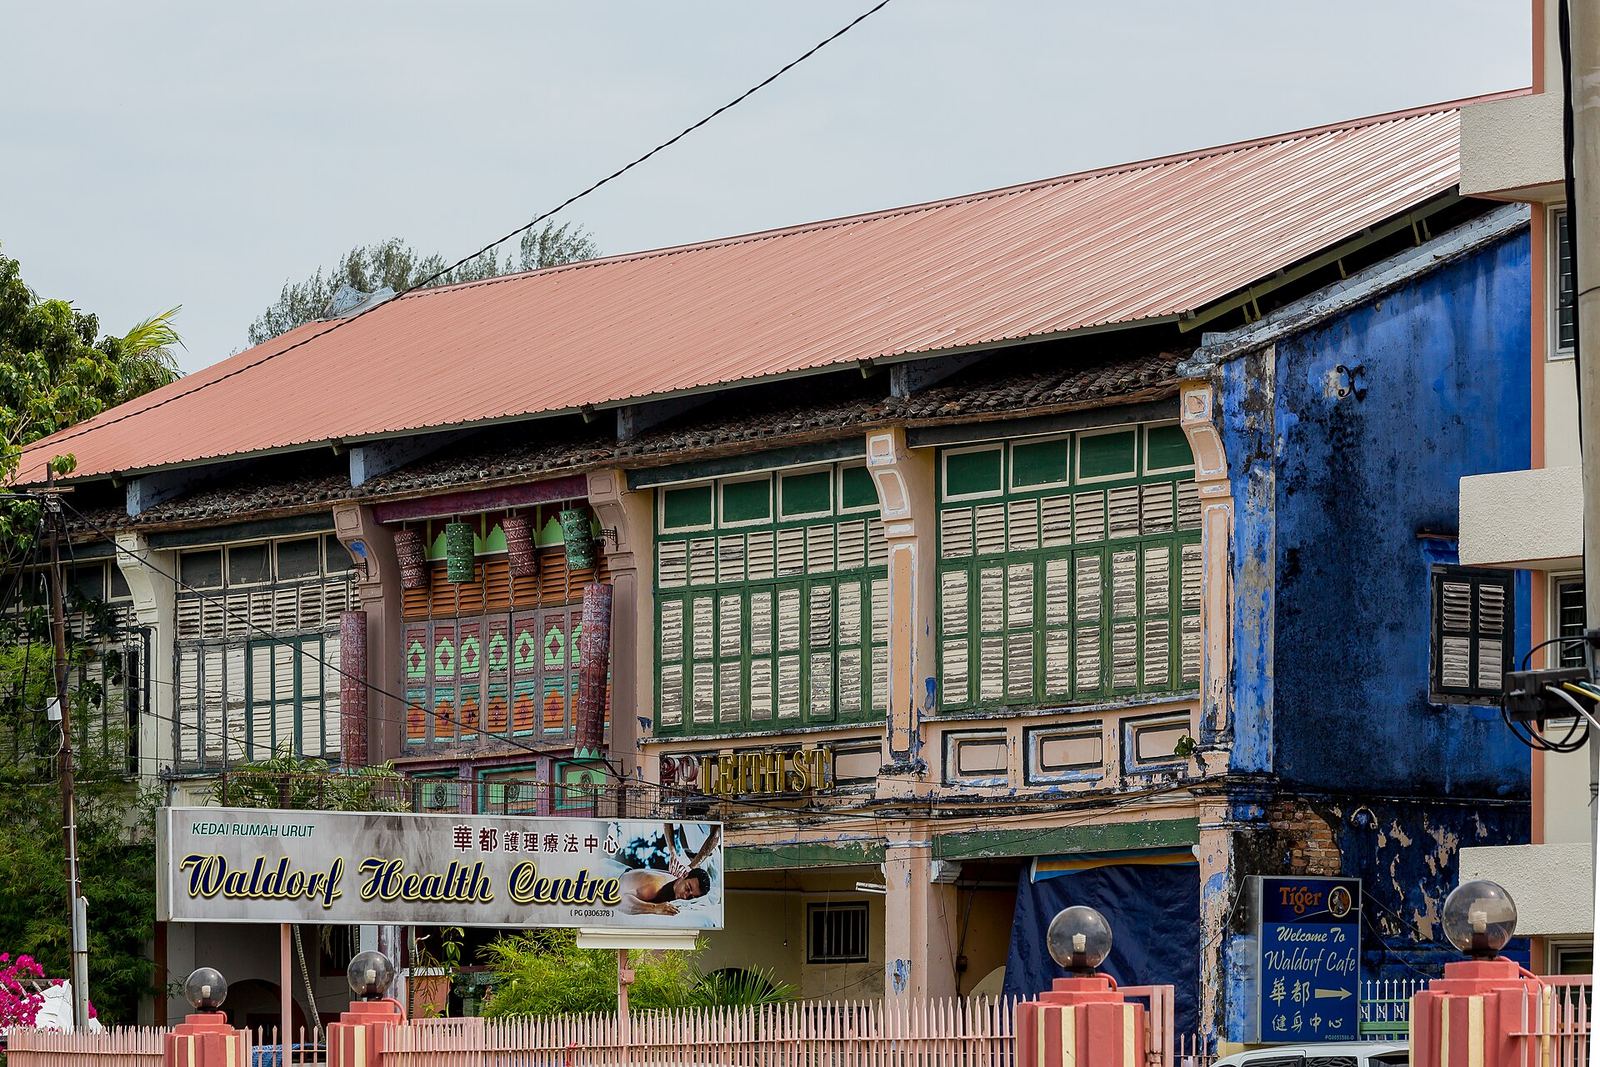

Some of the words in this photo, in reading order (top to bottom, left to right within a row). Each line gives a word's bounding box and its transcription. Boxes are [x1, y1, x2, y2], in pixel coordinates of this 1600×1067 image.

[701, 751, 788, 795] LEITH
[191, 822, 229, 836] KEDAI
[231, 823, 279, 837] RUMAH
[281, 824, 315, 838] URUT
[180, 853, 345, 909] Waldorf
[358, 857, 494, 903] Health
[508, 861, 622, 907] Centre
[1279, 886, 1323, 914] Tiger
[1276, 926, 1329, 943] Welcome
[1330, 927, 1346, 943] To
[1264, 947, 1326, 977] Waldorf
[1326, 947, 1356, 977] Cafe
[1269, 976, 1311, 1008] 華都
[1271, 1010, 1343, 1034] 健身中心
